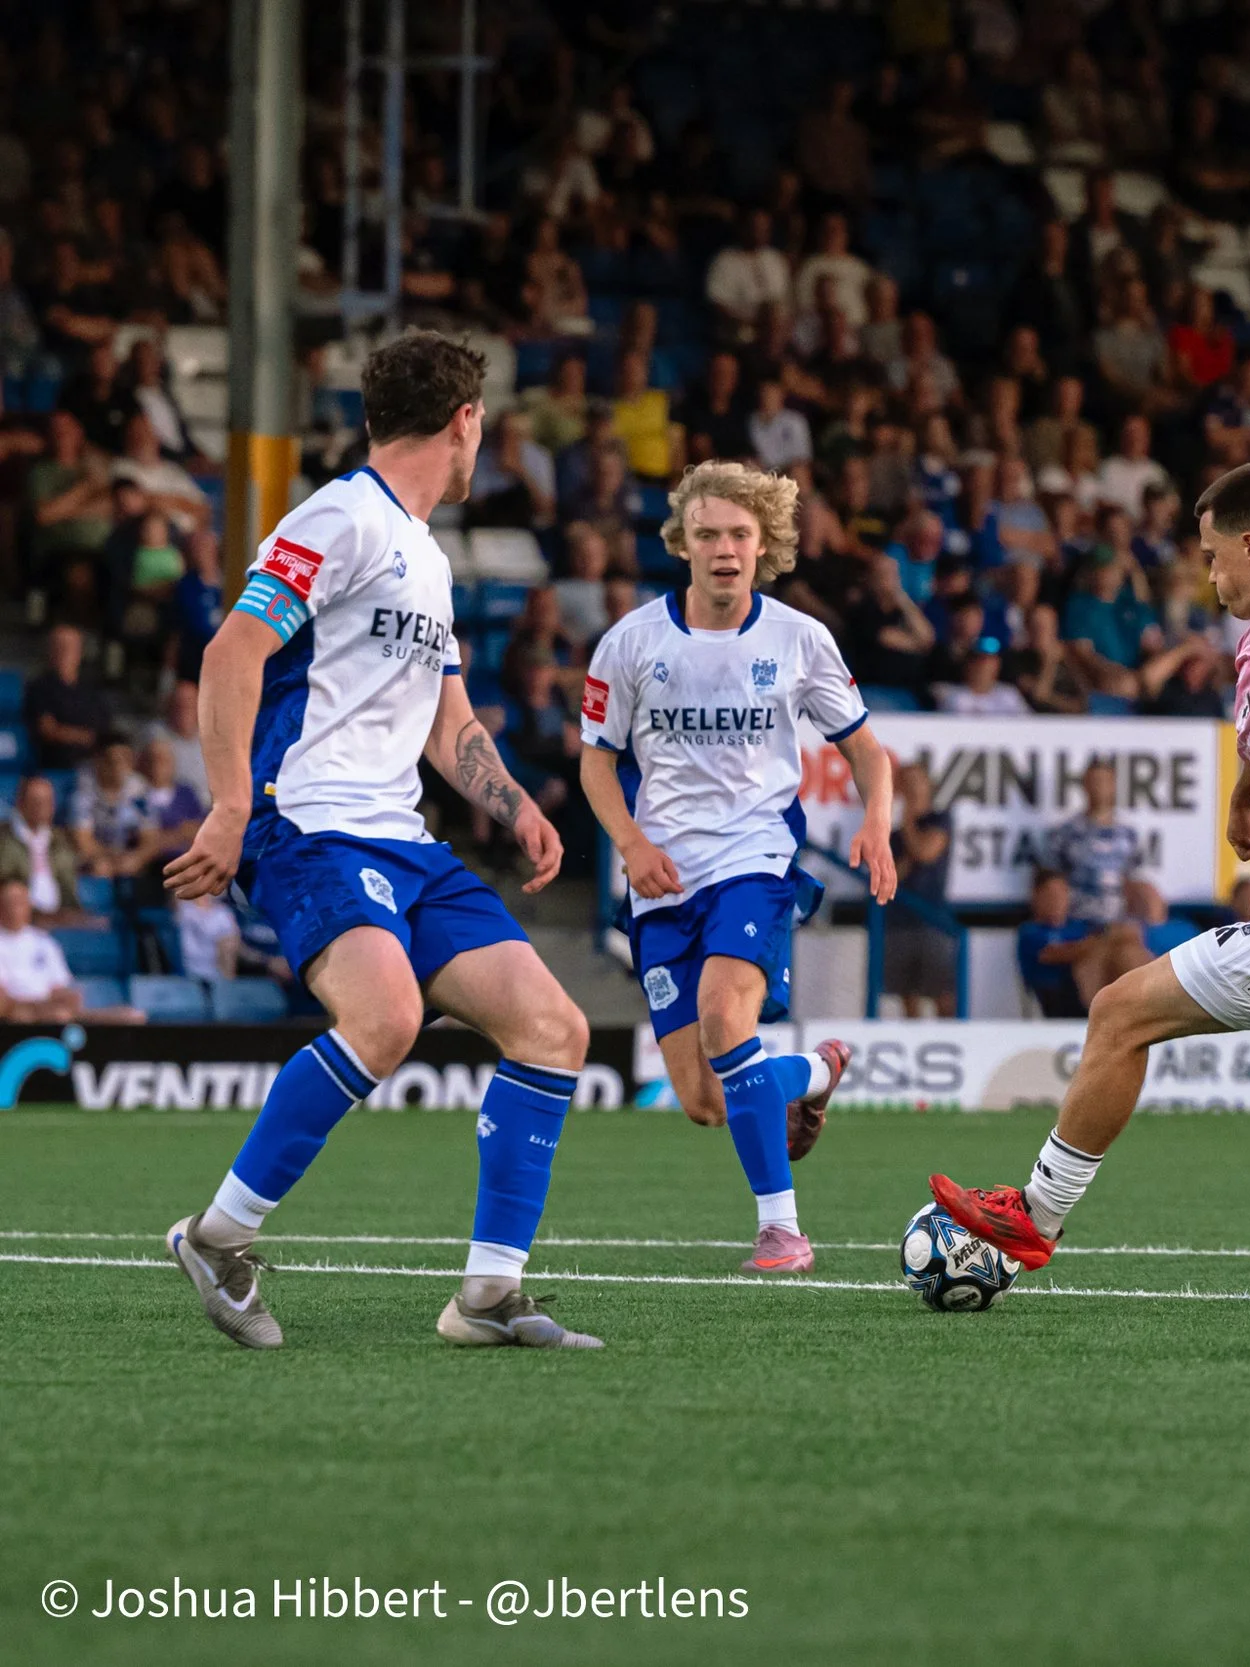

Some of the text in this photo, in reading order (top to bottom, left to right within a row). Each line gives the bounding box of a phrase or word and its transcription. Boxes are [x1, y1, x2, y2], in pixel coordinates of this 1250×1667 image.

[266, 593, 291, 621] C
[649, 707, 775, 731] EYELEVEL
[1055, 748, 1198, 810] HRE
[1154, 1045, 1221, 1083] AIR
